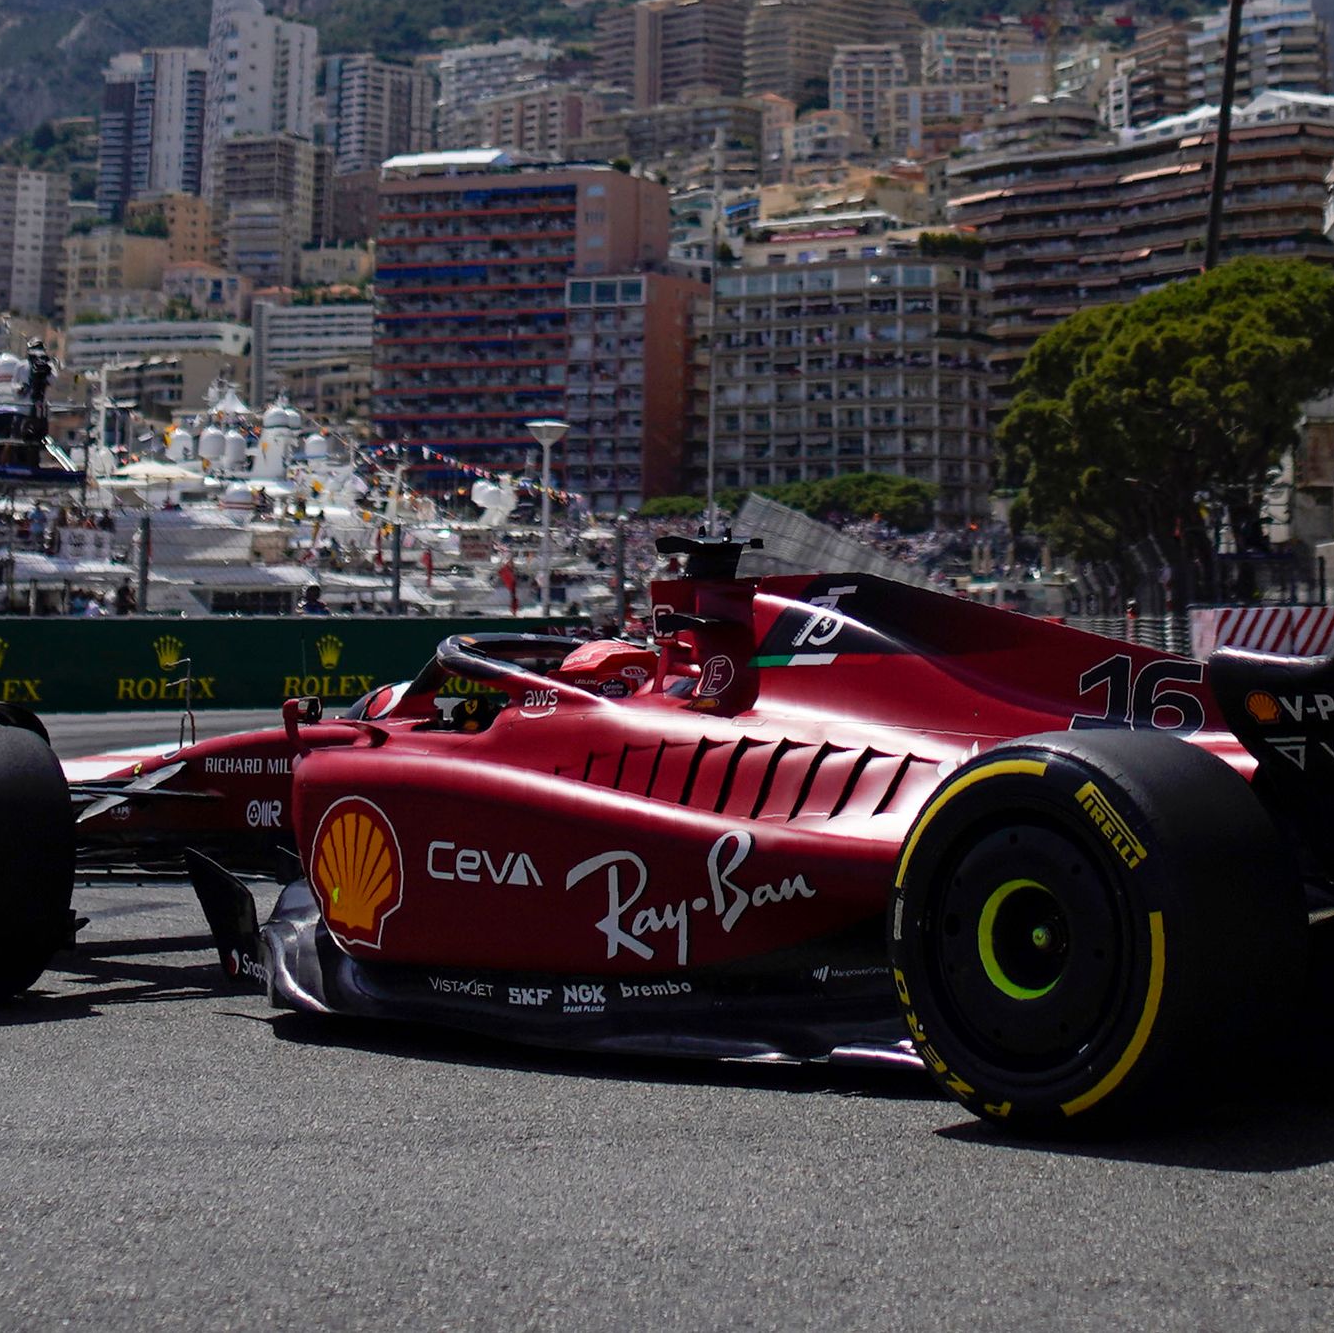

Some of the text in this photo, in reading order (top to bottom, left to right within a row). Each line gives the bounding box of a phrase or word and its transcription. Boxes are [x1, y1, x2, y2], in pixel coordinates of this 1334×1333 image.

[116, 676, 216, 701] ROLEX
[283, 675, 374, 698] ROLEX
[1067, 653, 1206, 738] 16
[524, 688, 559, 707] aws
[204, 757, 263, 774] RICHARD
[1074, 780, 1148, 869] PIRELLI
[508, 987, 553, 1006] SKF
[562, 984, 607, 1004] NGK
[619, 980, 692, 998] brembo
